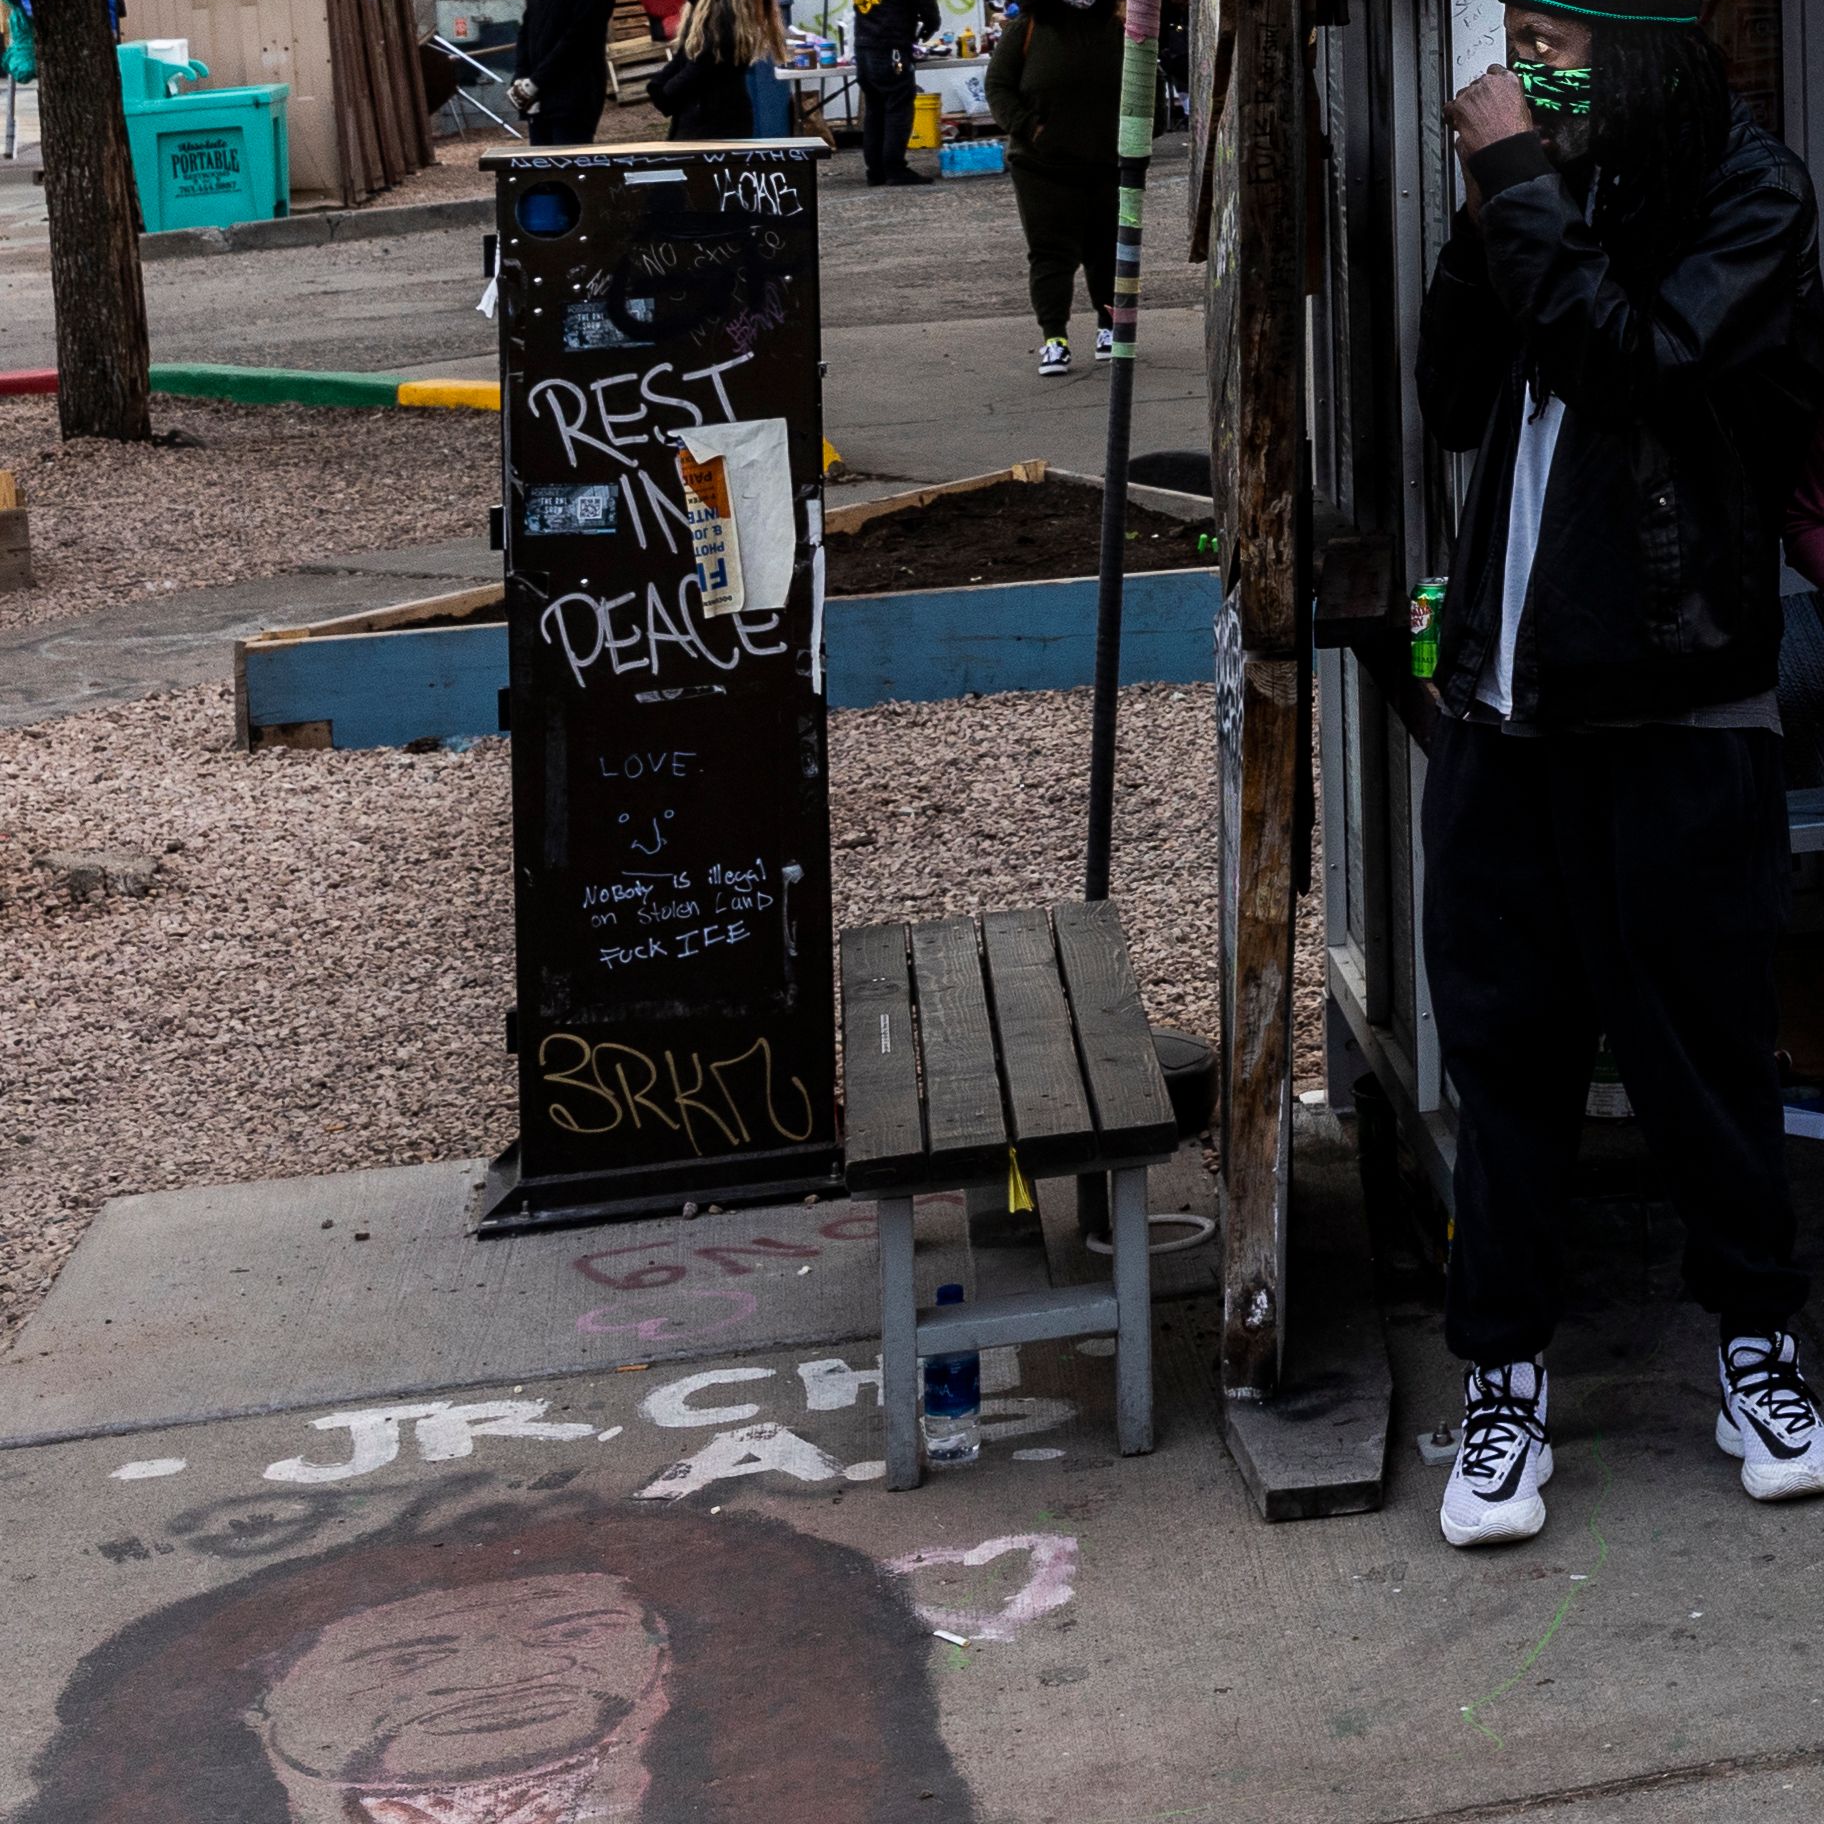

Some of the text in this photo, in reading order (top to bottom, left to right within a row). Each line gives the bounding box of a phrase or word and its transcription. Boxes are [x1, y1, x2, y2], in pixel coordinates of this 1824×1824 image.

[172, 148, 240, 179] PORTABLE
[528, 352, 755, 468] REST
[621, 469, 694, 554] IN
[541, 574, 788, 688] PEACE
[600, 752, 697, 779] LOVE
